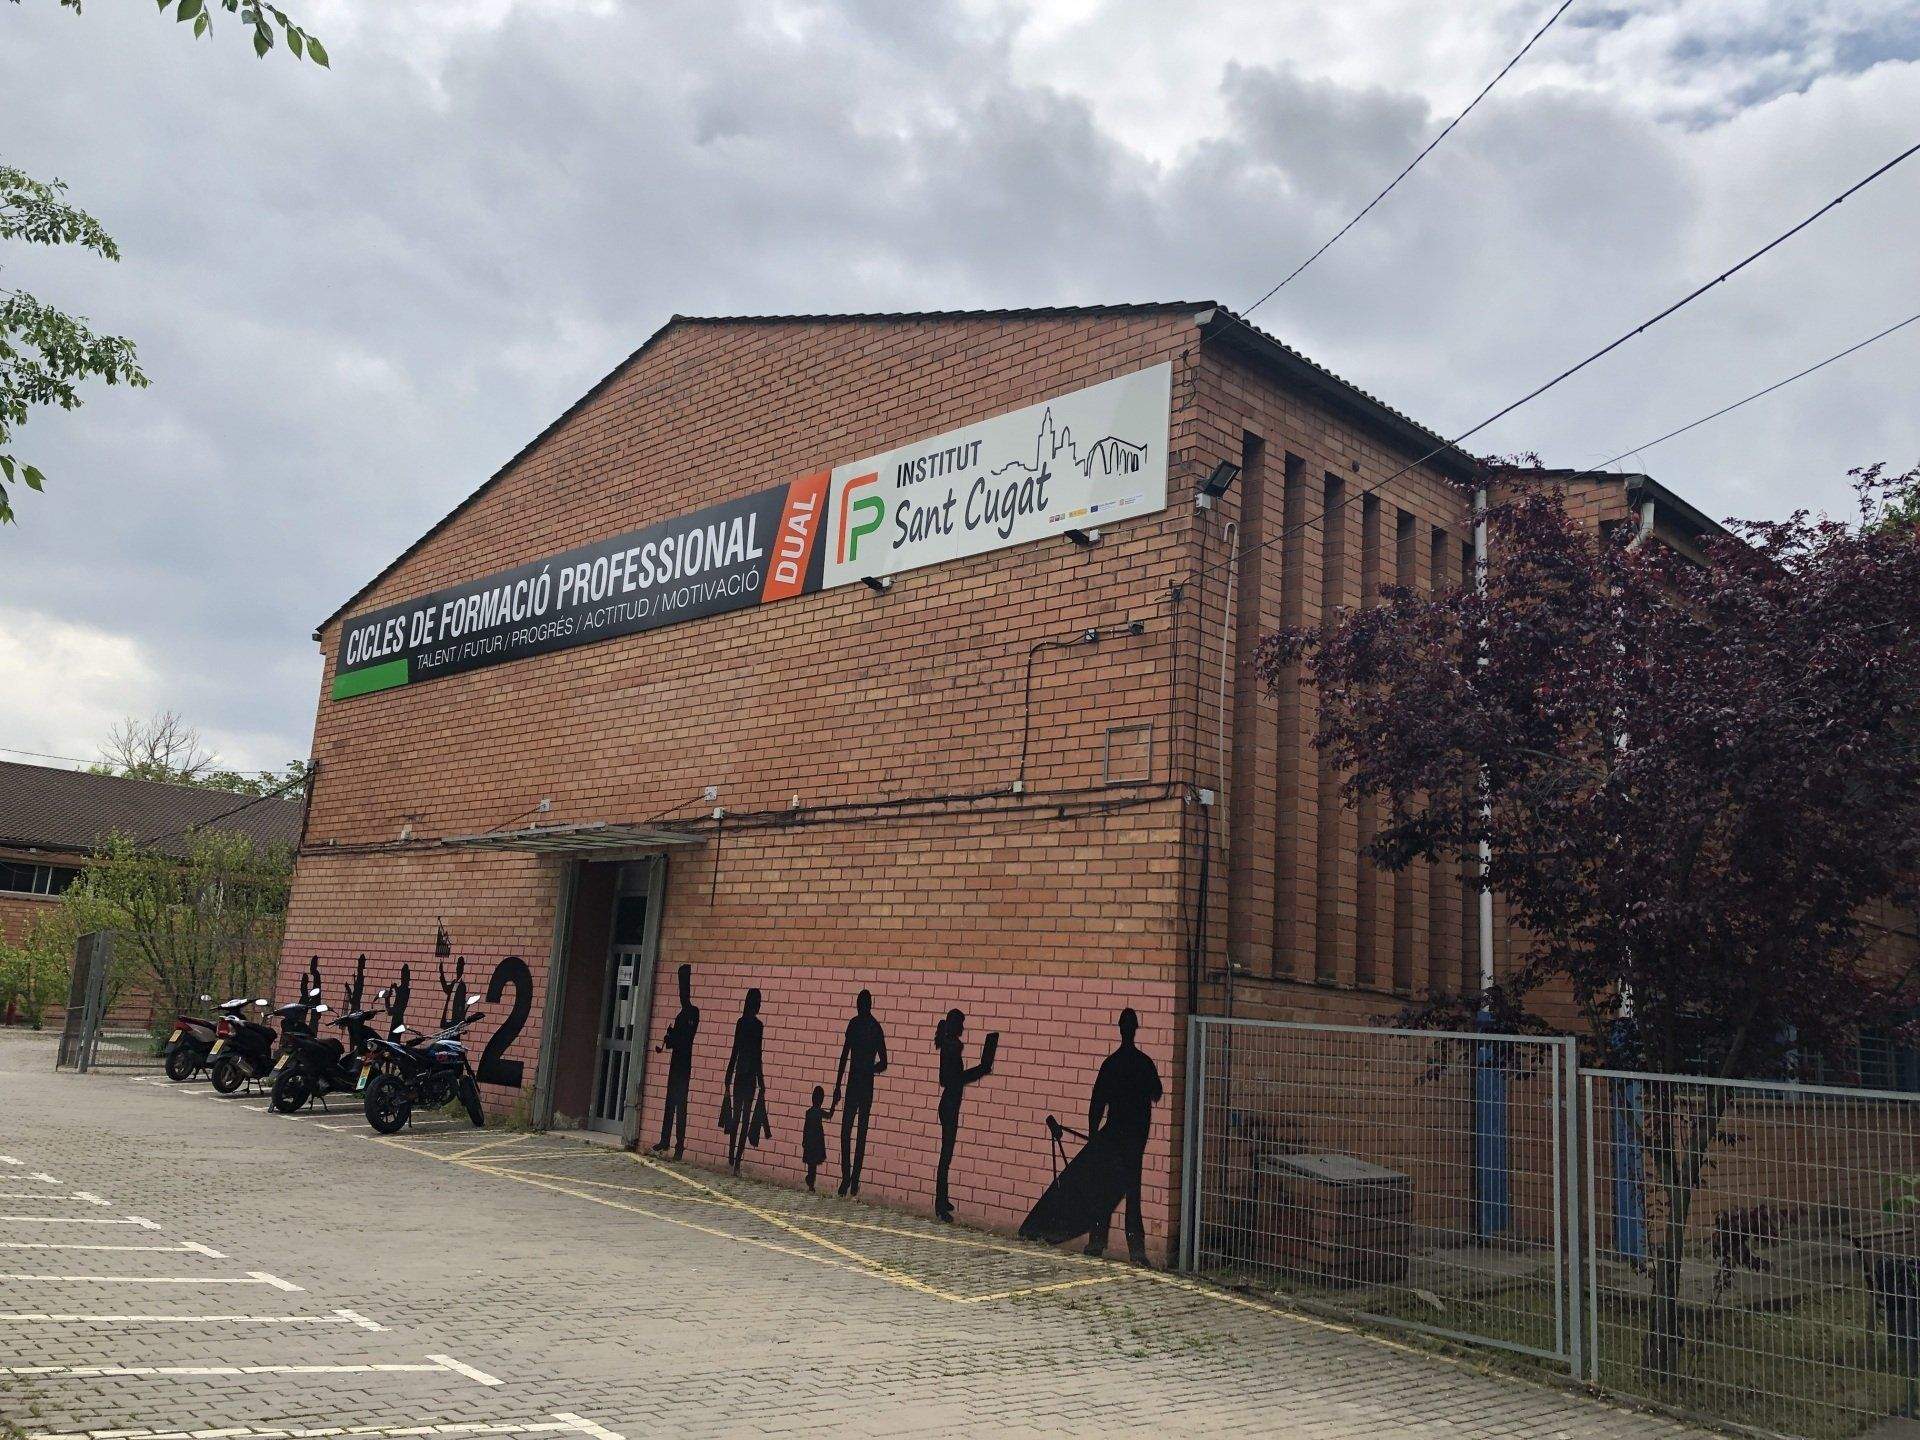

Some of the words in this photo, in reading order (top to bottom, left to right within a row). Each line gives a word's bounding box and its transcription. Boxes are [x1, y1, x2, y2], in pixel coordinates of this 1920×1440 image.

[892, 487, 957, 550] Sant
[964, 461, 1052, 540] Cugat
[896, 439, 982, 488] INSTITUT
[774, 492, 817, 584] DUAL
[346, 615, 406, 666] CICLES
[409, 606, 437, 649] DE
[438, 564, 551, 640] FORMACIÓ
[556, 512, 763, 610] PROFESSIONAL
[417, 646, 458, 670] TALENT
[463, 635, 502, 659] FUTUR
[511, 614, 574, 647] PROGRÉS
[583, 598, 649, 631] ACTITUD
[661, 565, 760, 612] MOTIVACIÓ
[476, 956, 533, 1088] 2
